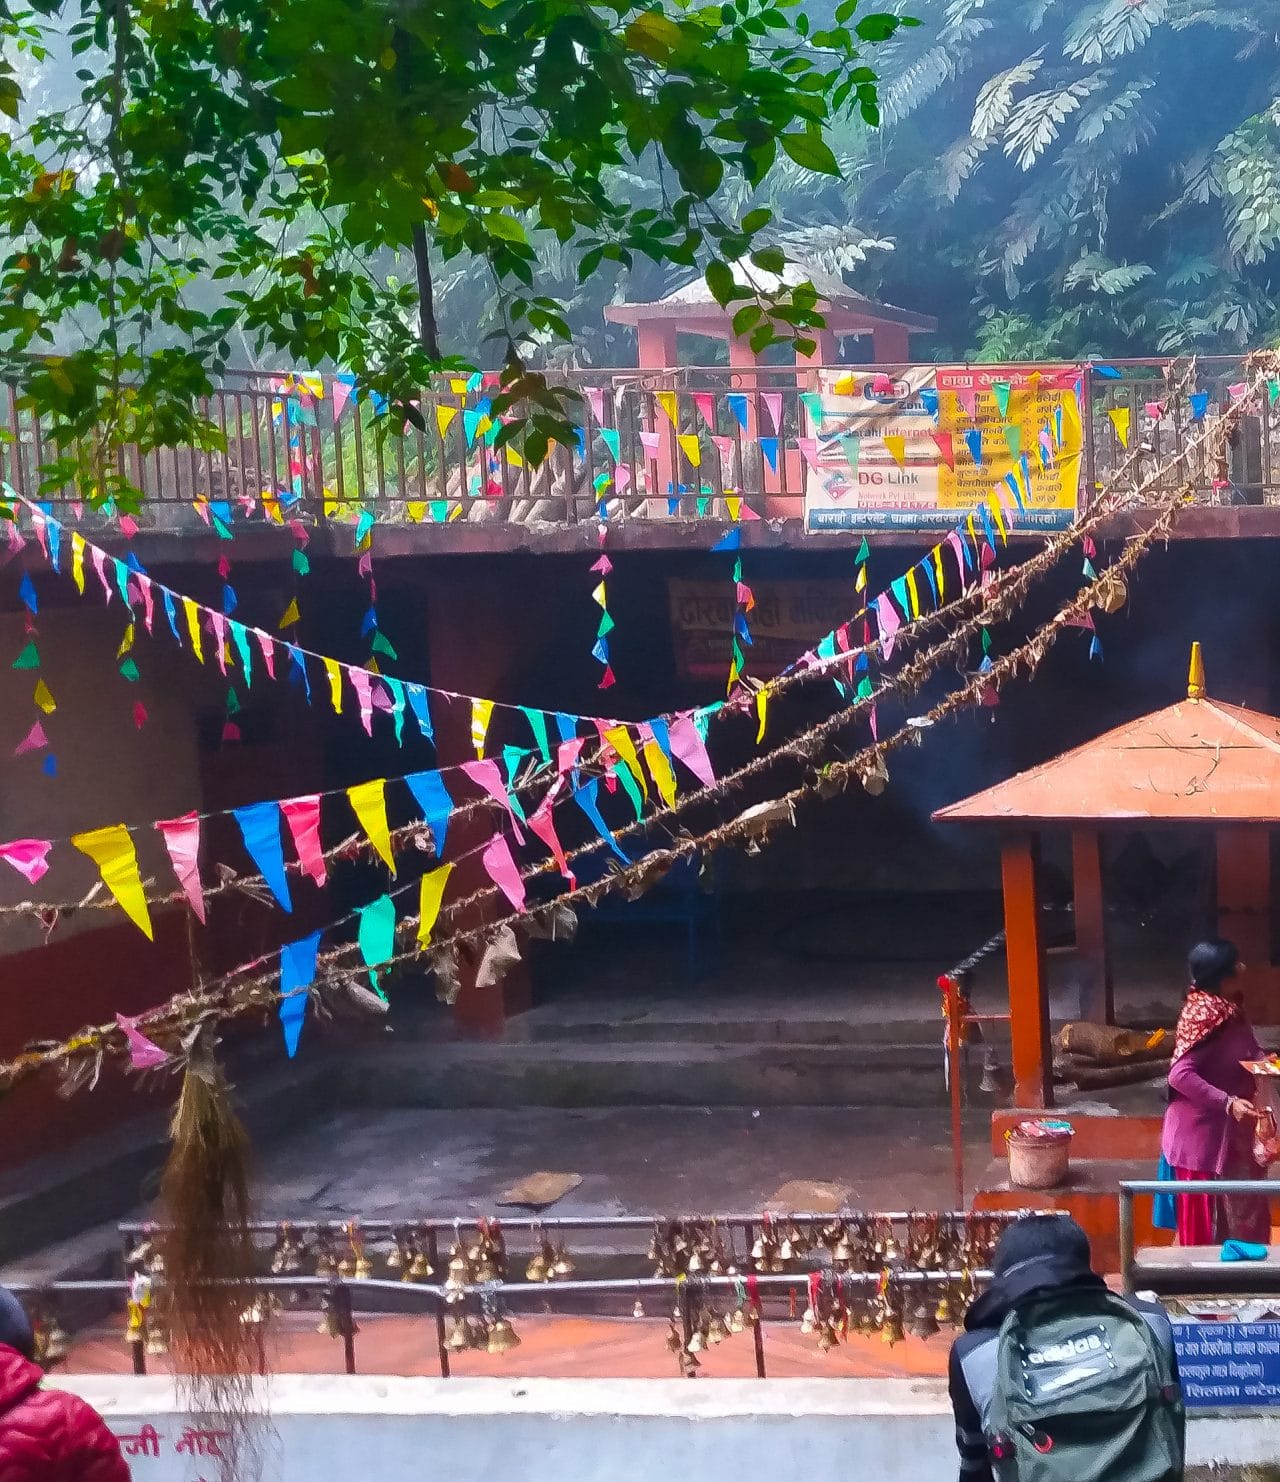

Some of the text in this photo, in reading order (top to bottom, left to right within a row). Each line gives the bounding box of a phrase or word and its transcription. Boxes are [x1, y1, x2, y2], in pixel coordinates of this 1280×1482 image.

[898, 401, 925, 411] Zon
[884, 427, 932, 438] Internet
[858, 471, 919, 485] DG Link
[1028, 1335, 1102, 1361] adidas
